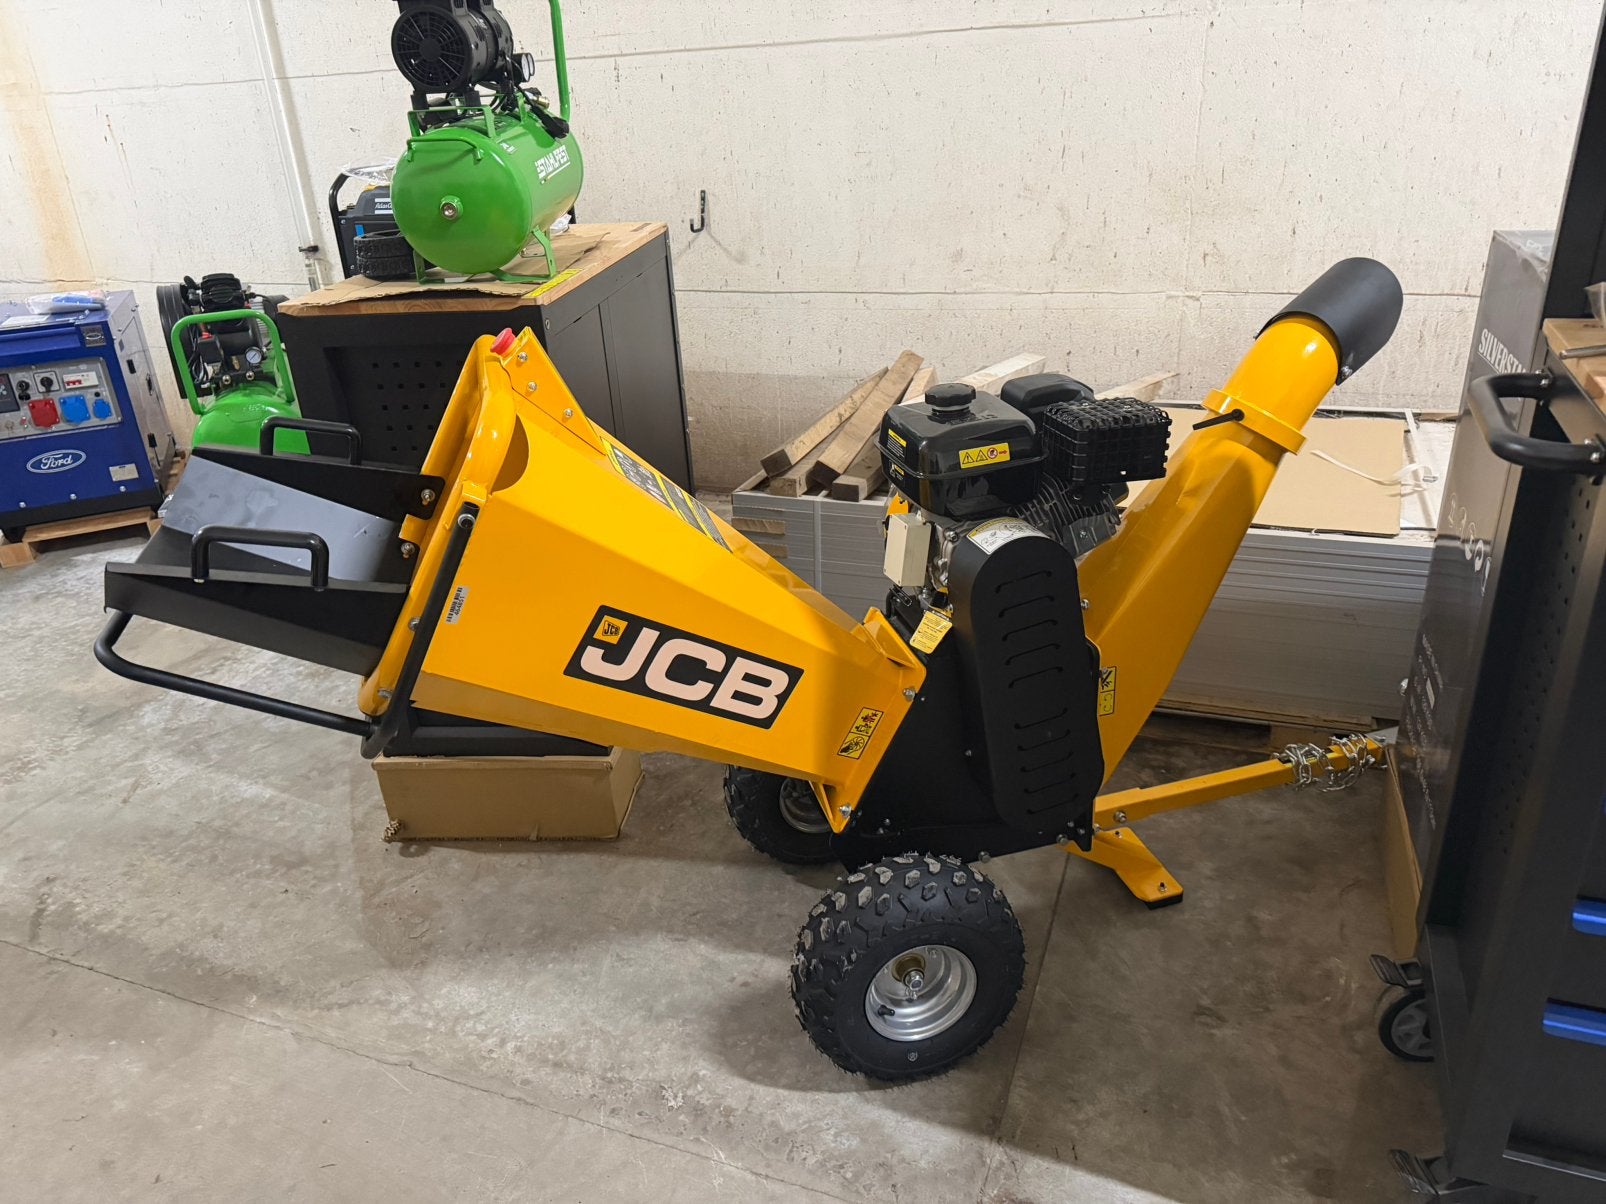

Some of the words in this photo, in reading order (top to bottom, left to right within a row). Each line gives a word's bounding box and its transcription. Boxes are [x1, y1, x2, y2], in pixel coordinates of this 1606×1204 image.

[40, 453, 73, 470] Ford
[604, 622, 620, 636] JCB
[580, 627, 790, 720] JCB
